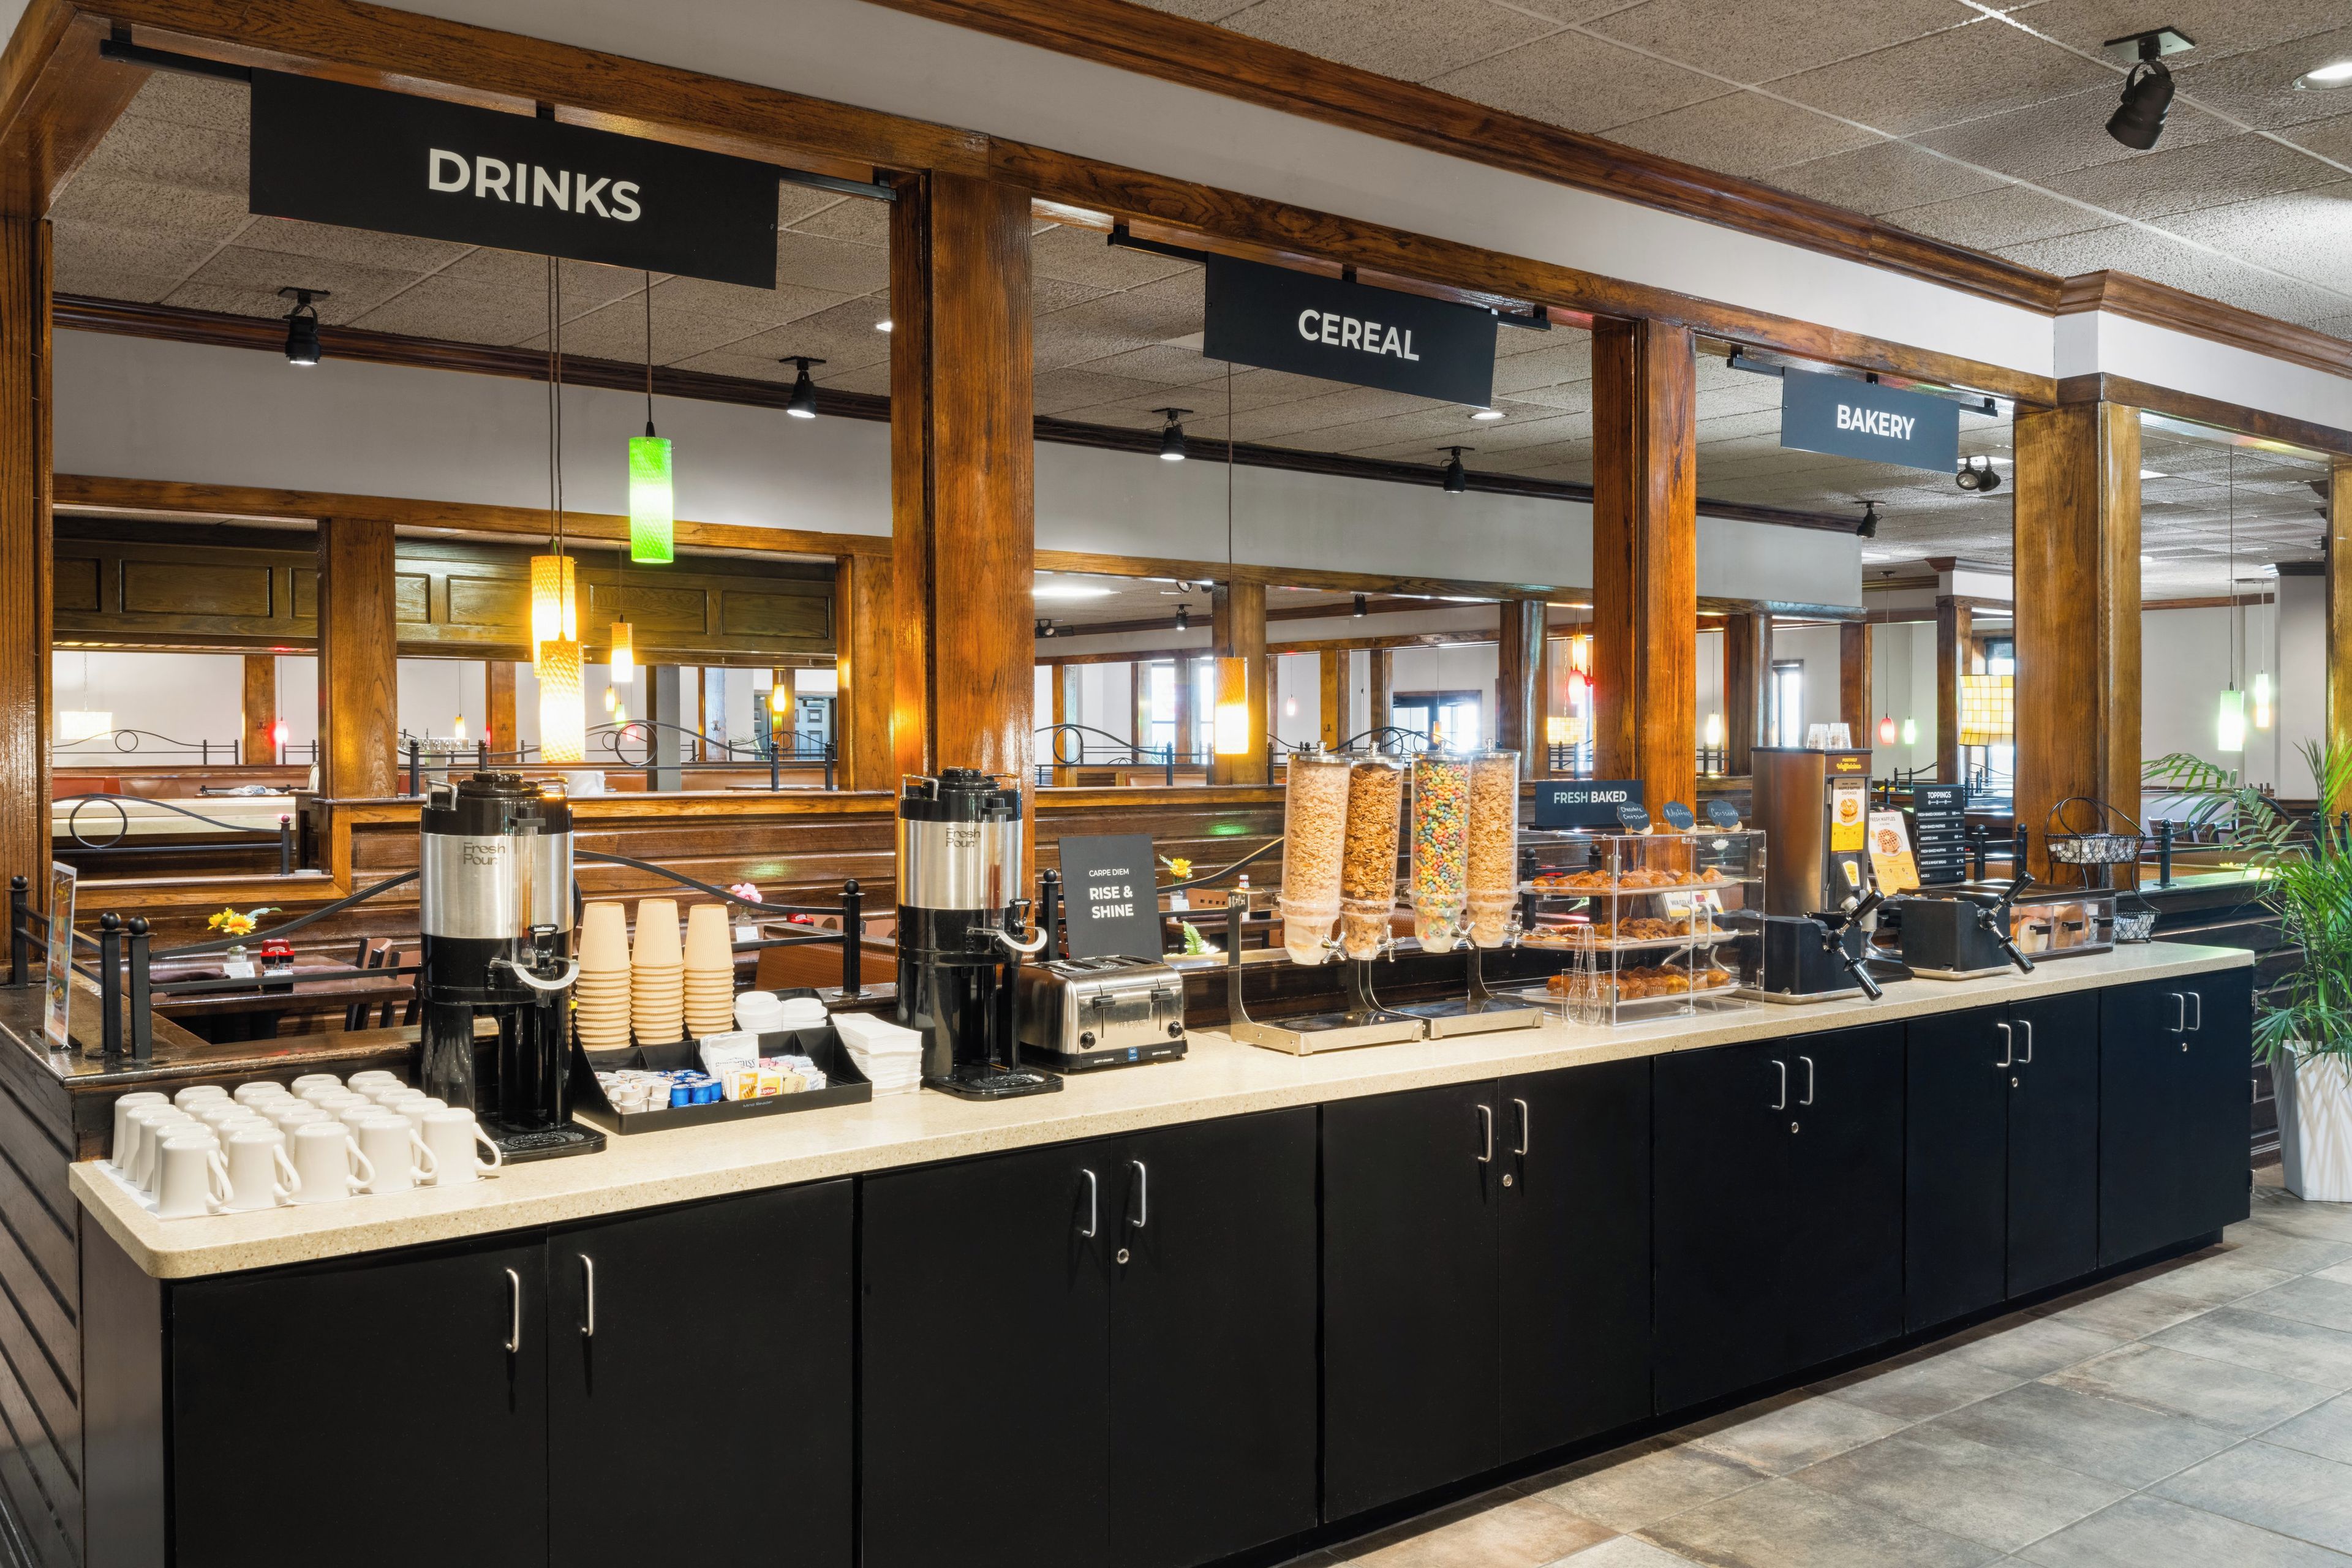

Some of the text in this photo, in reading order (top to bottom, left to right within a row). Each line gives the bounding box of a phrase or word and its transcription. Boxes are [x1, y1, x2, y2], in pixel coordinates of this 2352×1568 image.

[429, 148, 641, 222] DRINKS
[1298, 309, 1419, 361] CEREAL
[1837, 404, 1915, 440] BAKERY
[1554, 791, 1627, 804] FRESH BAKED
[1666, 809, 1692, 818] Muffins
[946, 828, 980, 838] Fresh
[463, 842, 505, 853] Fresh
[1089, 885, 1133, 900] RISE &
[1091, 903, 1134, 919] SHINE
